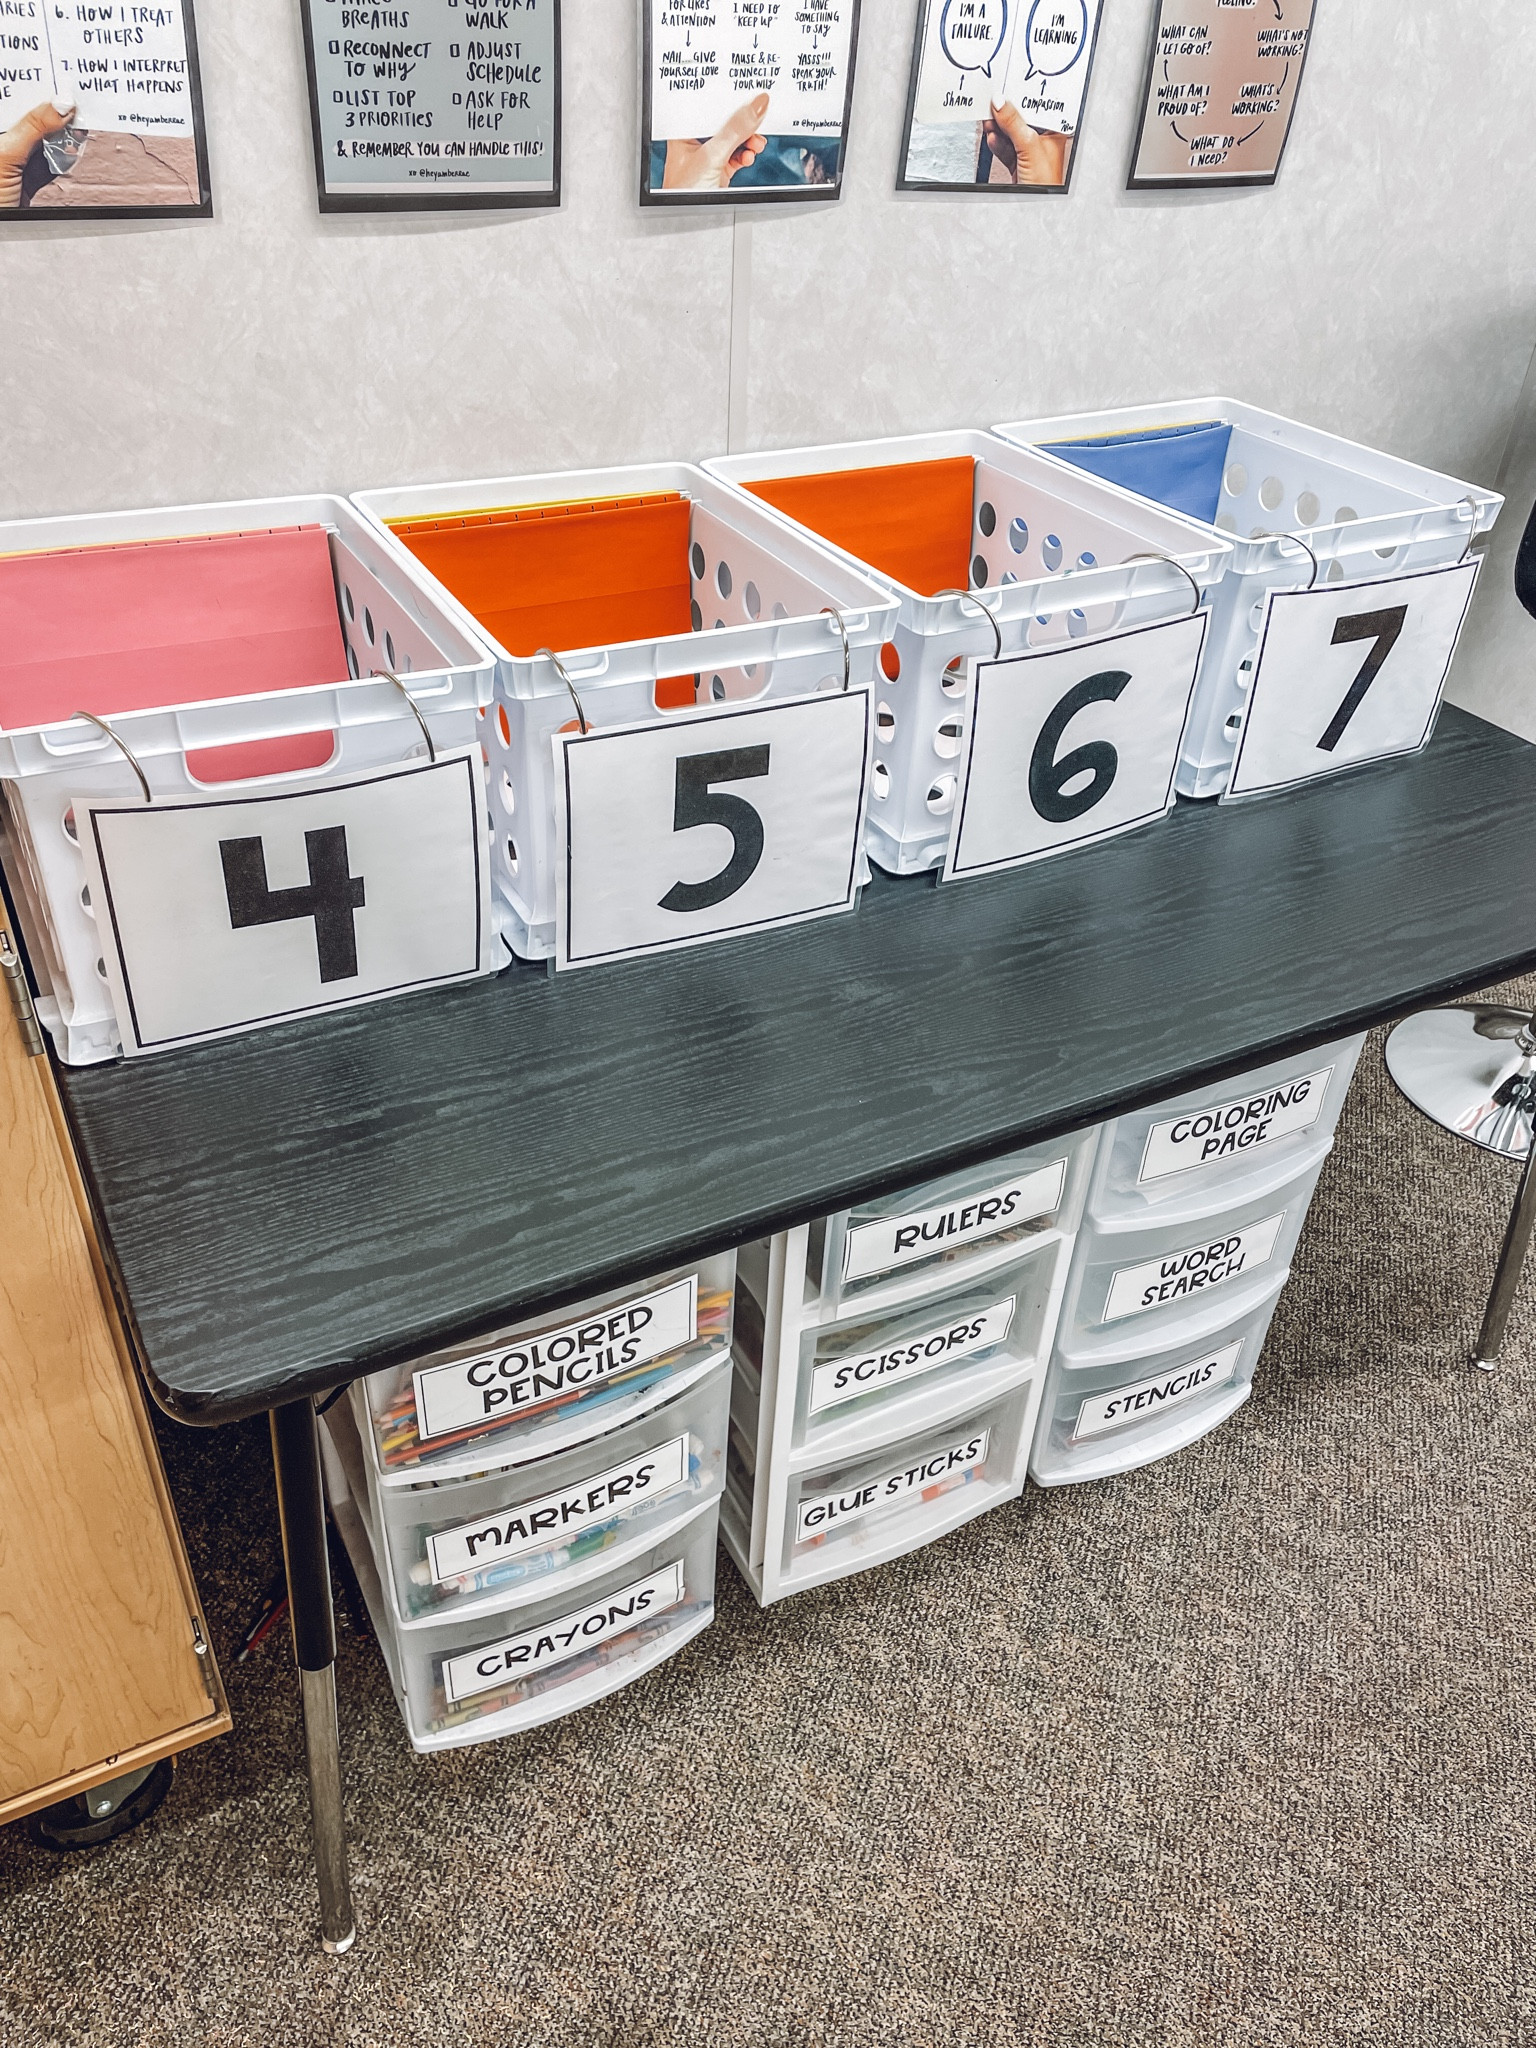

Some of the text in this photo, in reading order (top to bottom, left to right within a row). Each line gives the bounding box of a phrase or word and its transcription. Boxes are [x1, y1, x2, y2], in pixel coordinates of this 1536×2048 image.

[77, 5, 112, 20] HOW
[121, 8, 124, 21] I
[131, 7, 173, 27] TREAT
[734, 3, 780, 14] I NEED TO
[960, 3, 985, 18] I'M A
[342, 11, 409, 29] BREATHS
[466, 12, 508, 29] WALK
[1052, 14, 1064, 27] I'M
[84, 28, 143, 46] OTHERS
[802, 24, 830, 37] TO SAY
[1161, 25, 1208, 40] WHAT CAN
[1257, 29, 1308, 42] WHAT'S NOT
[344, 40, 431, 58] RECONNECT
[467, 42, 522, 59] ADJUST
[1164, 42, 1177, 54] LET
[1181, 43, 1194, 54] GO
[1196, 41, 1212, 55] OF?
[1258, 45, 1303, 57] WORKING?
[78, 59, 108, 72] HOW
[114, 60, 117, 71] I
[124, 58, 187, 74] INTERPRET
[732, 53, 755, 64] PAUSE
[759, 52, 765, 64] &
[345, 61, 416, 81] TO WHY
[467, 63, 541, 84] SCHEDULE
[659, 66, 718, 79] YOURSELF LOVE
[729, 67, 780, 77] CONNECT TO
[792, 68, 814, 79] SPEAK
[79, 78, 119, 93] WHAT
[670, 79, 704, 90] INSTEAD
[734, 80, 754, 90] YOUR
[1158, 84, 1210, 100] WHAT AM I
[1241, 83, 1275, 97] WHAT'S
[346, 90, 416, 107] LIST TOP
[466, 91, 530, 109] ASK FOR
[1158, 100, 1207, 116] PROUD OF?
[1232, 100, 1280, 115] WORKING?
[346, 112, 433, 128] 3 PRIORITIES
[468, 112, 503, 130] HELP
[337, 140, 348, 157] &
[352, 142, 411, 157] REMEMBER
[417, 142, 439, 157] YOU
[444, 142, 465, 156] CAN
[470, 142, 510, 157] HANDLE
[1191, 136, 1234, 150] WHAT DO
[1191, 152, 1227, 166] I NEED?
[1315, 603, 1409, 752] 7
[1028, 669, 1134, 824] 6
[657, 744, 774, 914] 5
[219, 824, 365, 984] 4
[1170, 1077, 1312, 1143] COLORING
[1199, 1120, 1267, 1160] PAGE
[893, 1189, 1022, 1254] RULERS
[1160, 1235, 1241, 1278] WORD
[1141, 1253, 1245, 1307] SEARCH
[467, 1305, 653, 1388] COLORED
[834, 1316, 987, 1390] SCISSORS
[483, 1335, 641, 1413] PENCILS
[1104, 1361, 1217, 1420] STENCILS
[804, 1438, 982, 1527] GLUE STICKS
[466, 1463, 656, 1557] MARKERS
[476, 1588, 656, 1677] CRAYONS
